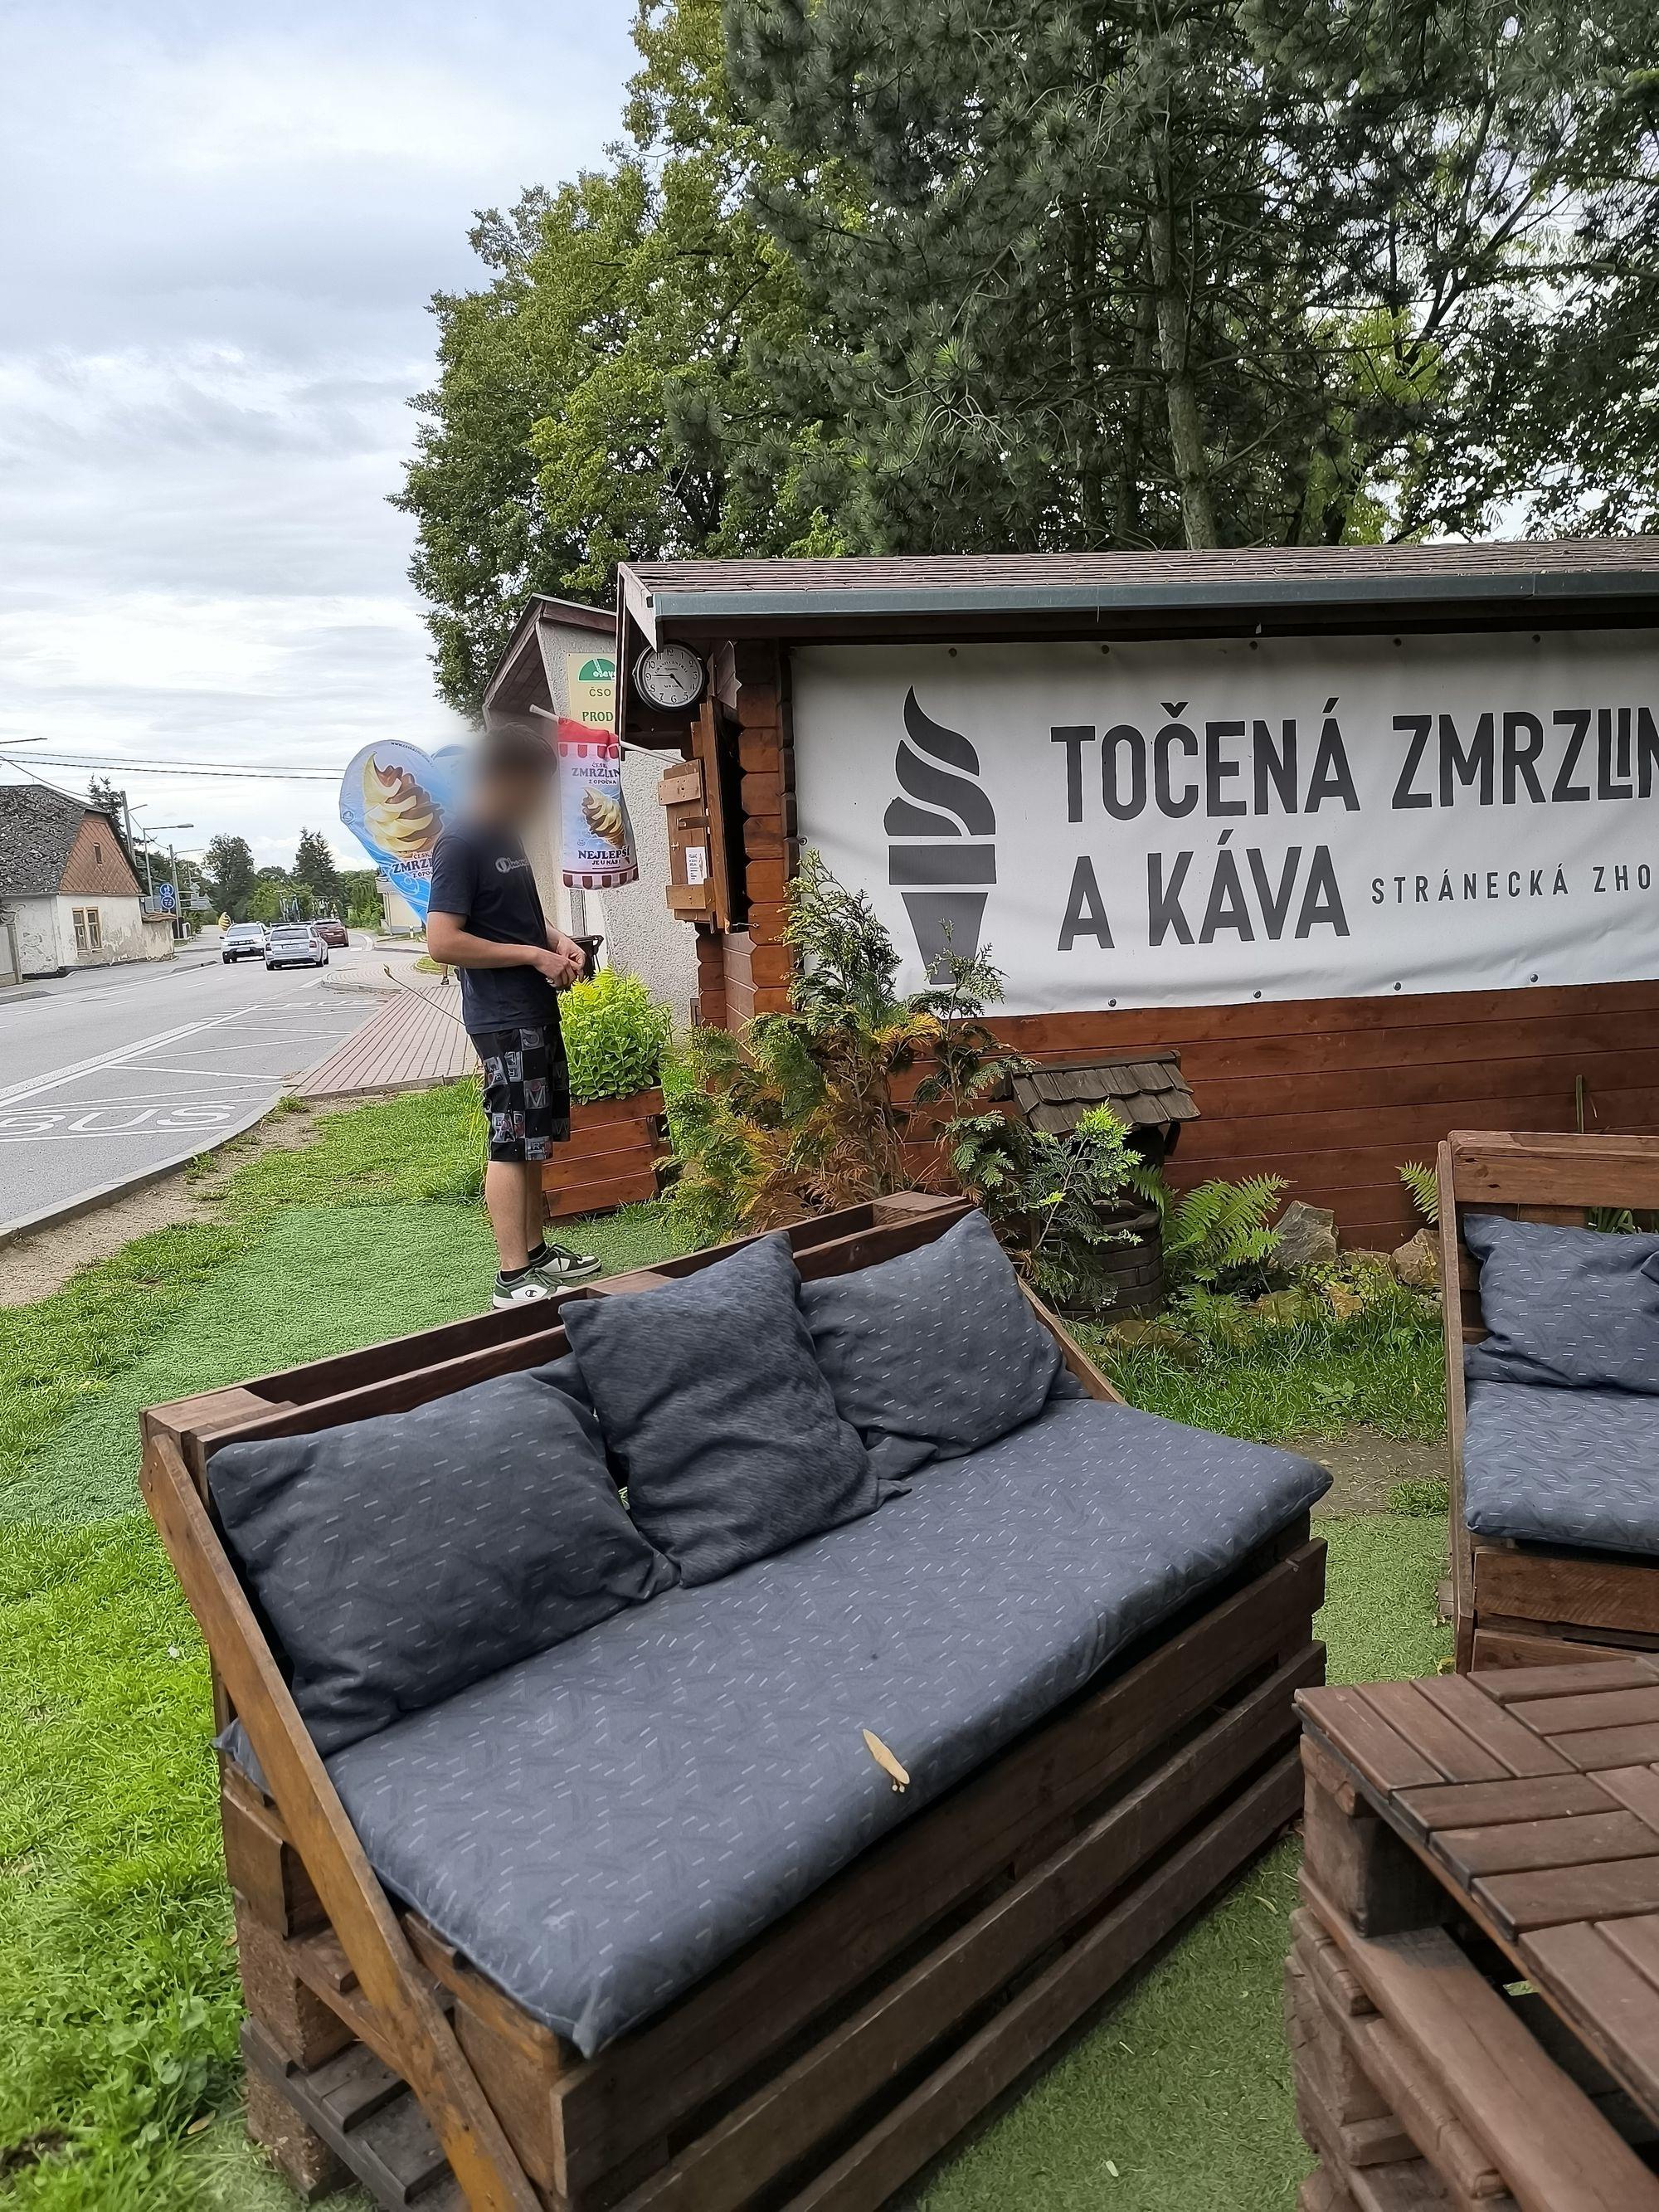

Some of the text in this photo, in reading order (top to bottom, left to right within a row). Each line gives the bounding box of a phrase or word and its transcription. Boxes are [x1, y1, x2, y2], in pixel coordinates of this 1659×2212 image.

[645, 673, 652, 681] 9
[670, 694, 677, 703] 6
[1051, 698, 1360, 822] TOČENÁ
[1058, 830, 1651, 951] A KÁVA STRÁNECKÁ ZHO
[0, 1105, 236, 1136] BUS
